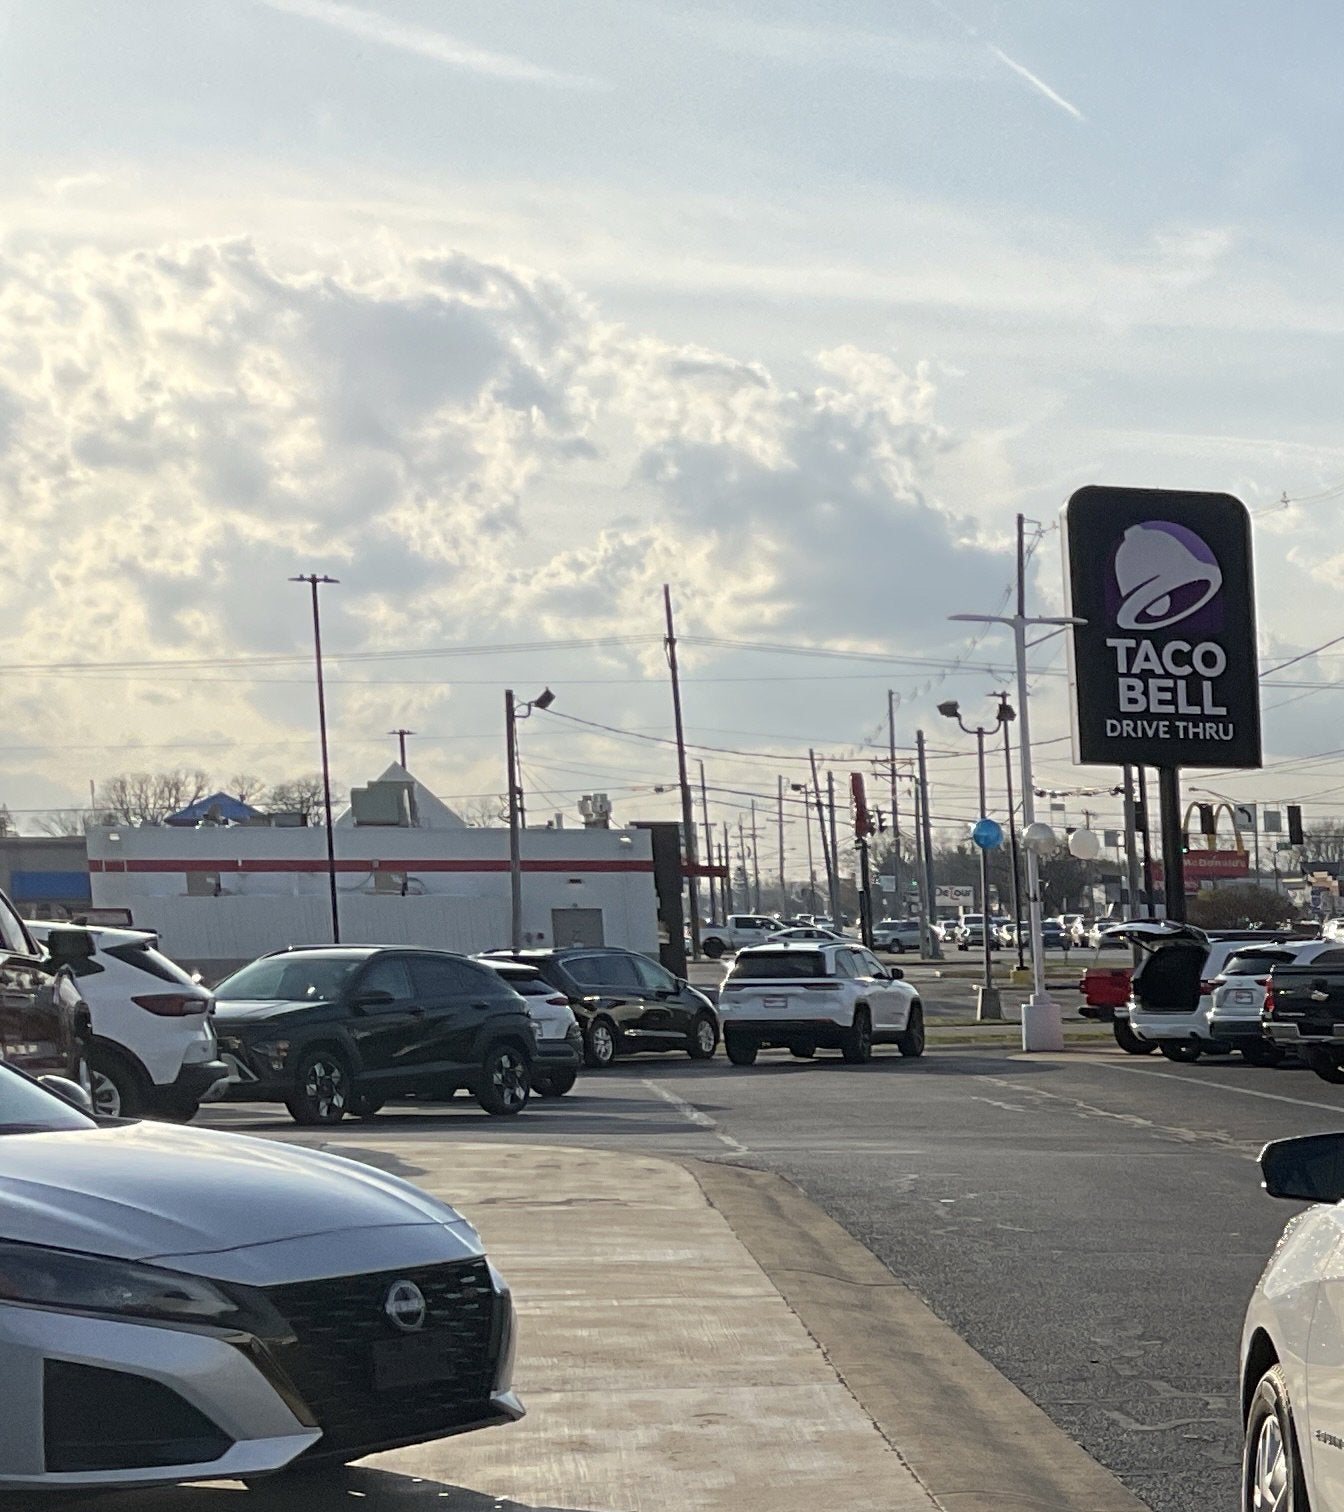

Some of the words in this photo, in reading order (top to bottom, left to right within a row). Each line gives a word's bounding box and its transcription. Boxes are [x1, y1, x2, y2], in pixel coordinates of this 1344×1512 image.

[1106, 638, 1227, 677] TACO
[1118, 678, 1227, 715] BELL
[1106, 719, 1170, 738] DRIVE
[1175, 721, 1233, 740] THRU
